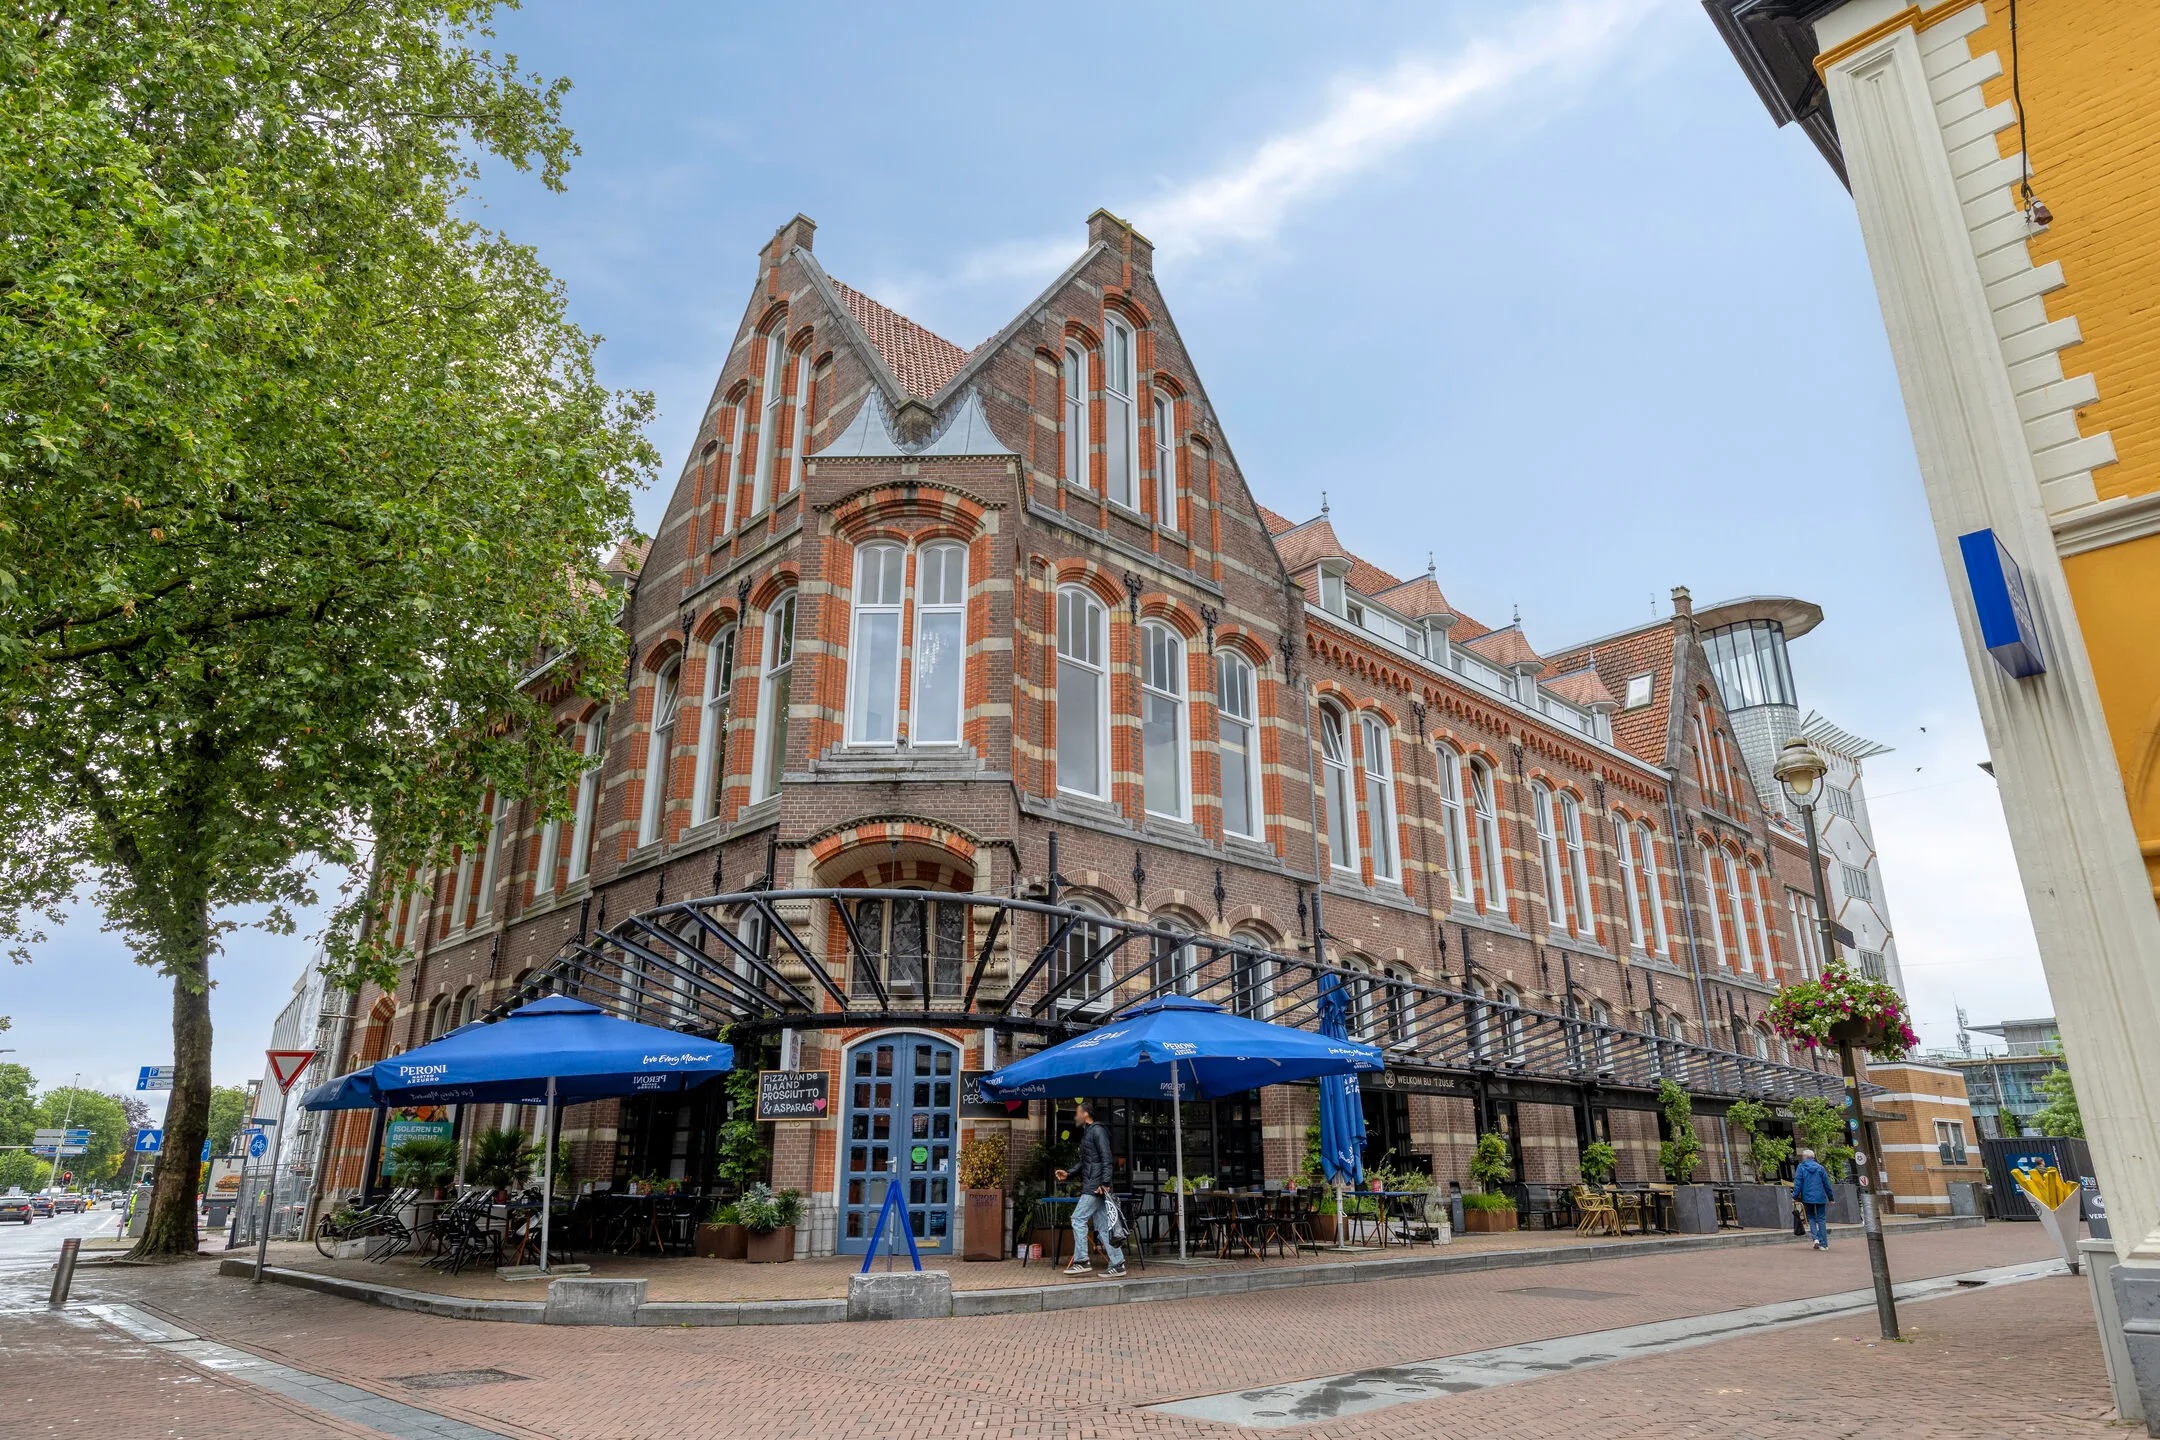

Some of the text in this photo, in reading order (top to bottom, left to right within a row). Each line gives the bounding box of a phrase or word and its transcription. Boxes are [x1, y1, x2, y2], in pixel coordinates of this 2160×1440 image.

[680, 1053, 712, 1065] Moment
[400, 1065, 448, 1077] PERONI
[789, 1073, 805, 1081] VAN
[1397, 1075, 1422, 1086] WELKOM
[762, 1101, 773, 1114] &
[393, 1125, 432, 1133] ISOLEREN
